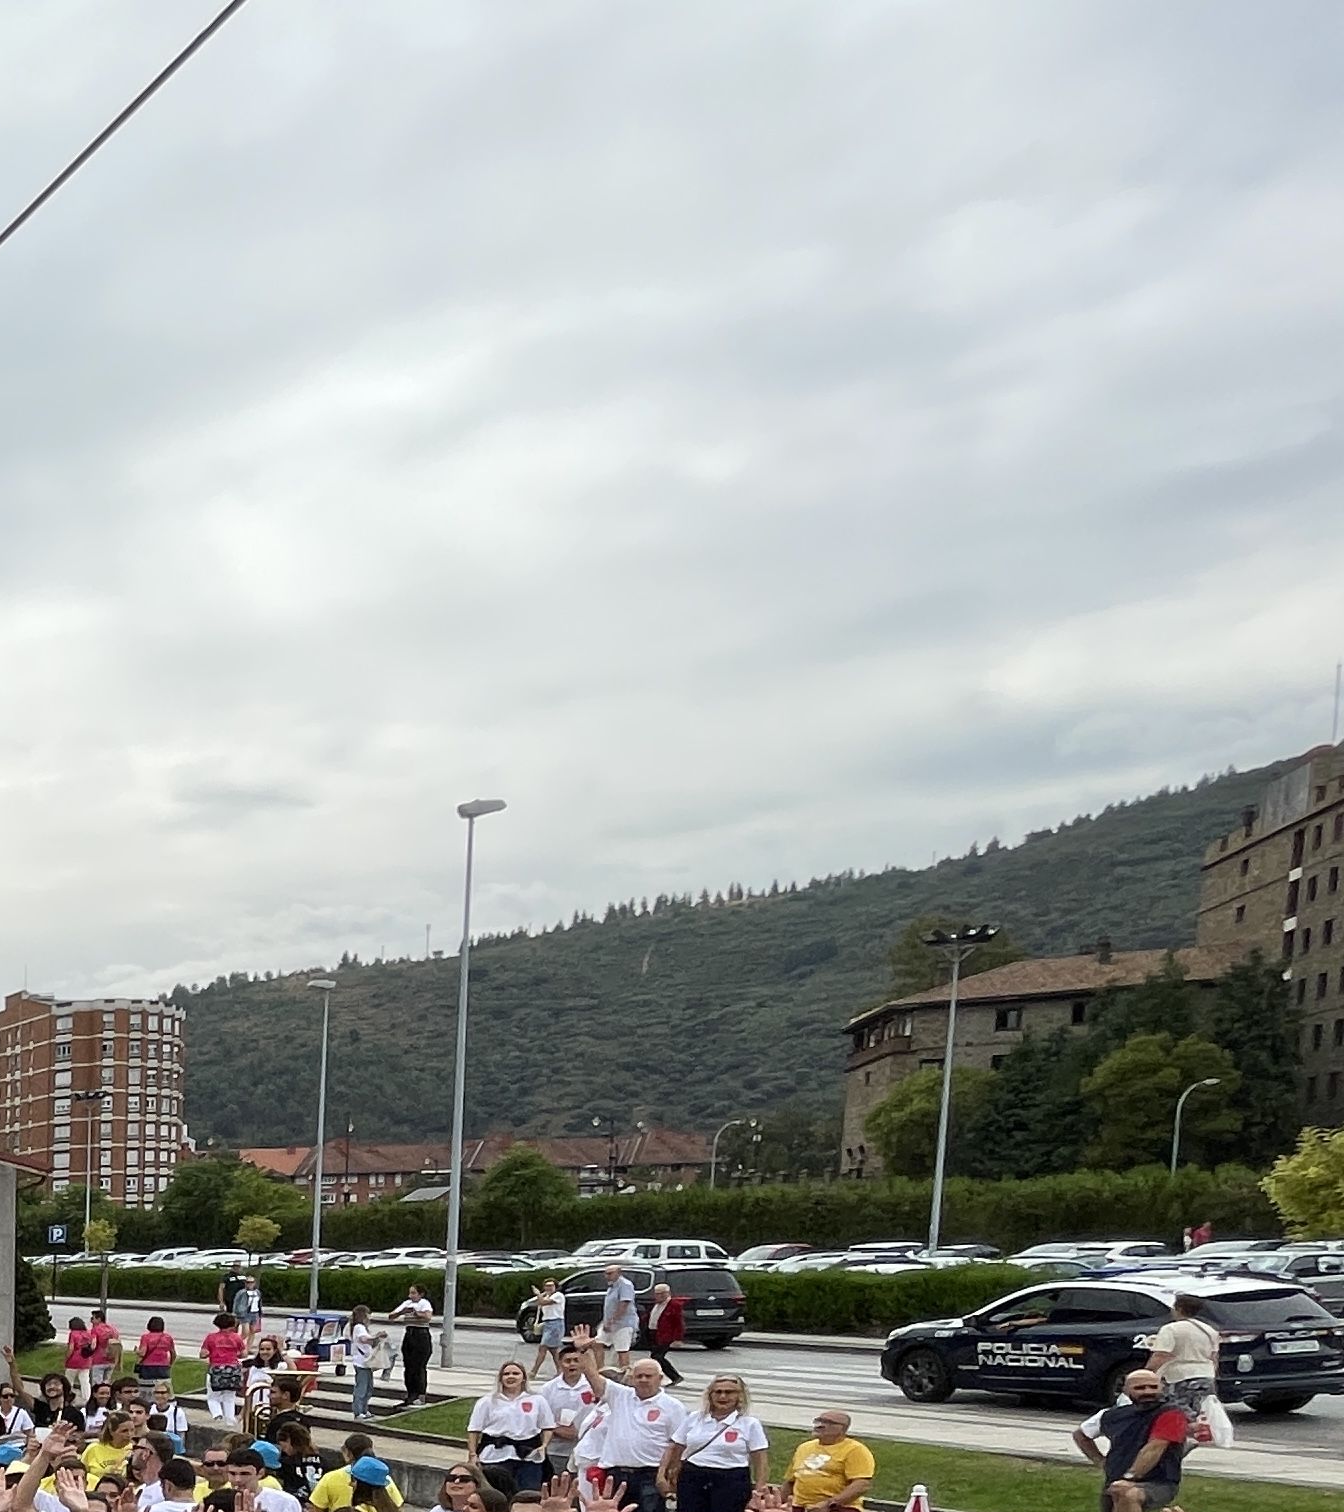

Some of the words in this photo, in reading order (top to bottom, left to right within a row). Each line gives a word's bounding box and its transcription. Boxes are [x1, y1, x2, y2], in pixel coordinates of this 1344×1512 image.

[52, 1228, 63, 1241] P
[977, 1342, 1061, 1356] POLICIA
[978, 1354, 1085, 1370] NACIONAL
